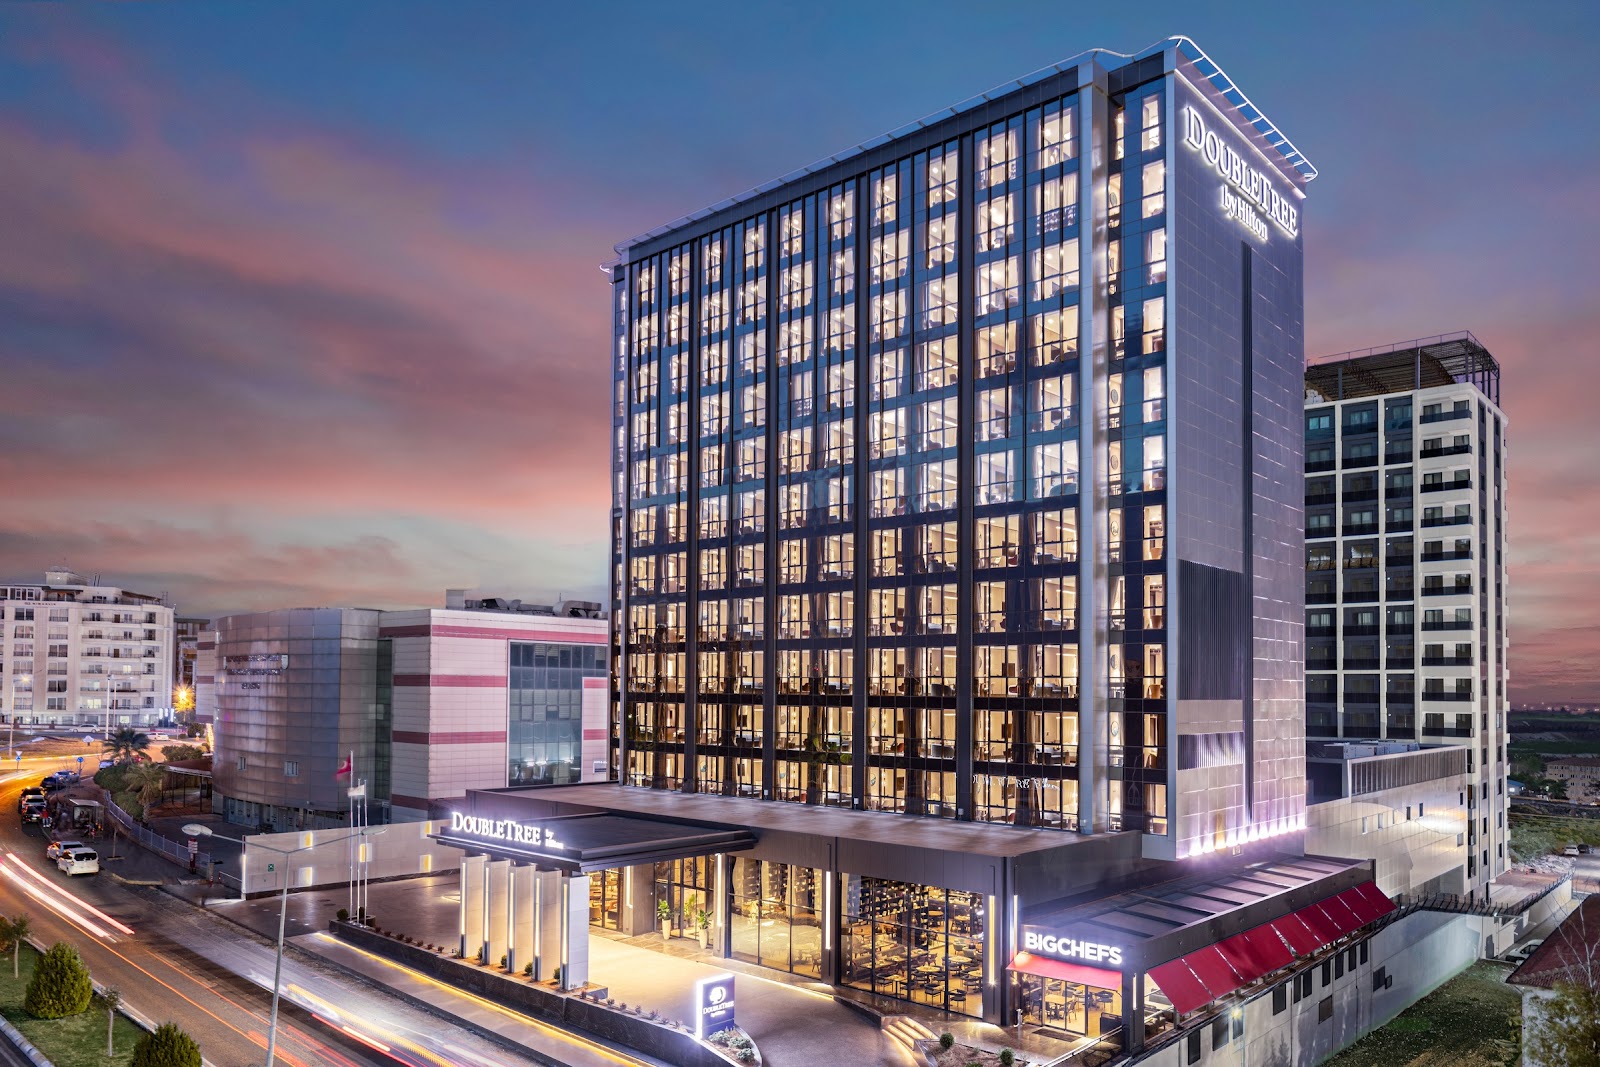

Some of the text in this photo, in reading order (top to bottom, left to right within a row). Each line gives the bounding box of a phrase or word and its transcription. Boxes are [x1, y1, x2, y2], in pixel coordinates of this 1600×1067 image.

[1185, 106, 1298, 235] DOUBLETREE
[1222, 185, 1268, 240] by Hilton
[451, 811, 542, 845] DOUBLETREE
[1025, 931, 1122, 965] BIGCHEFS
